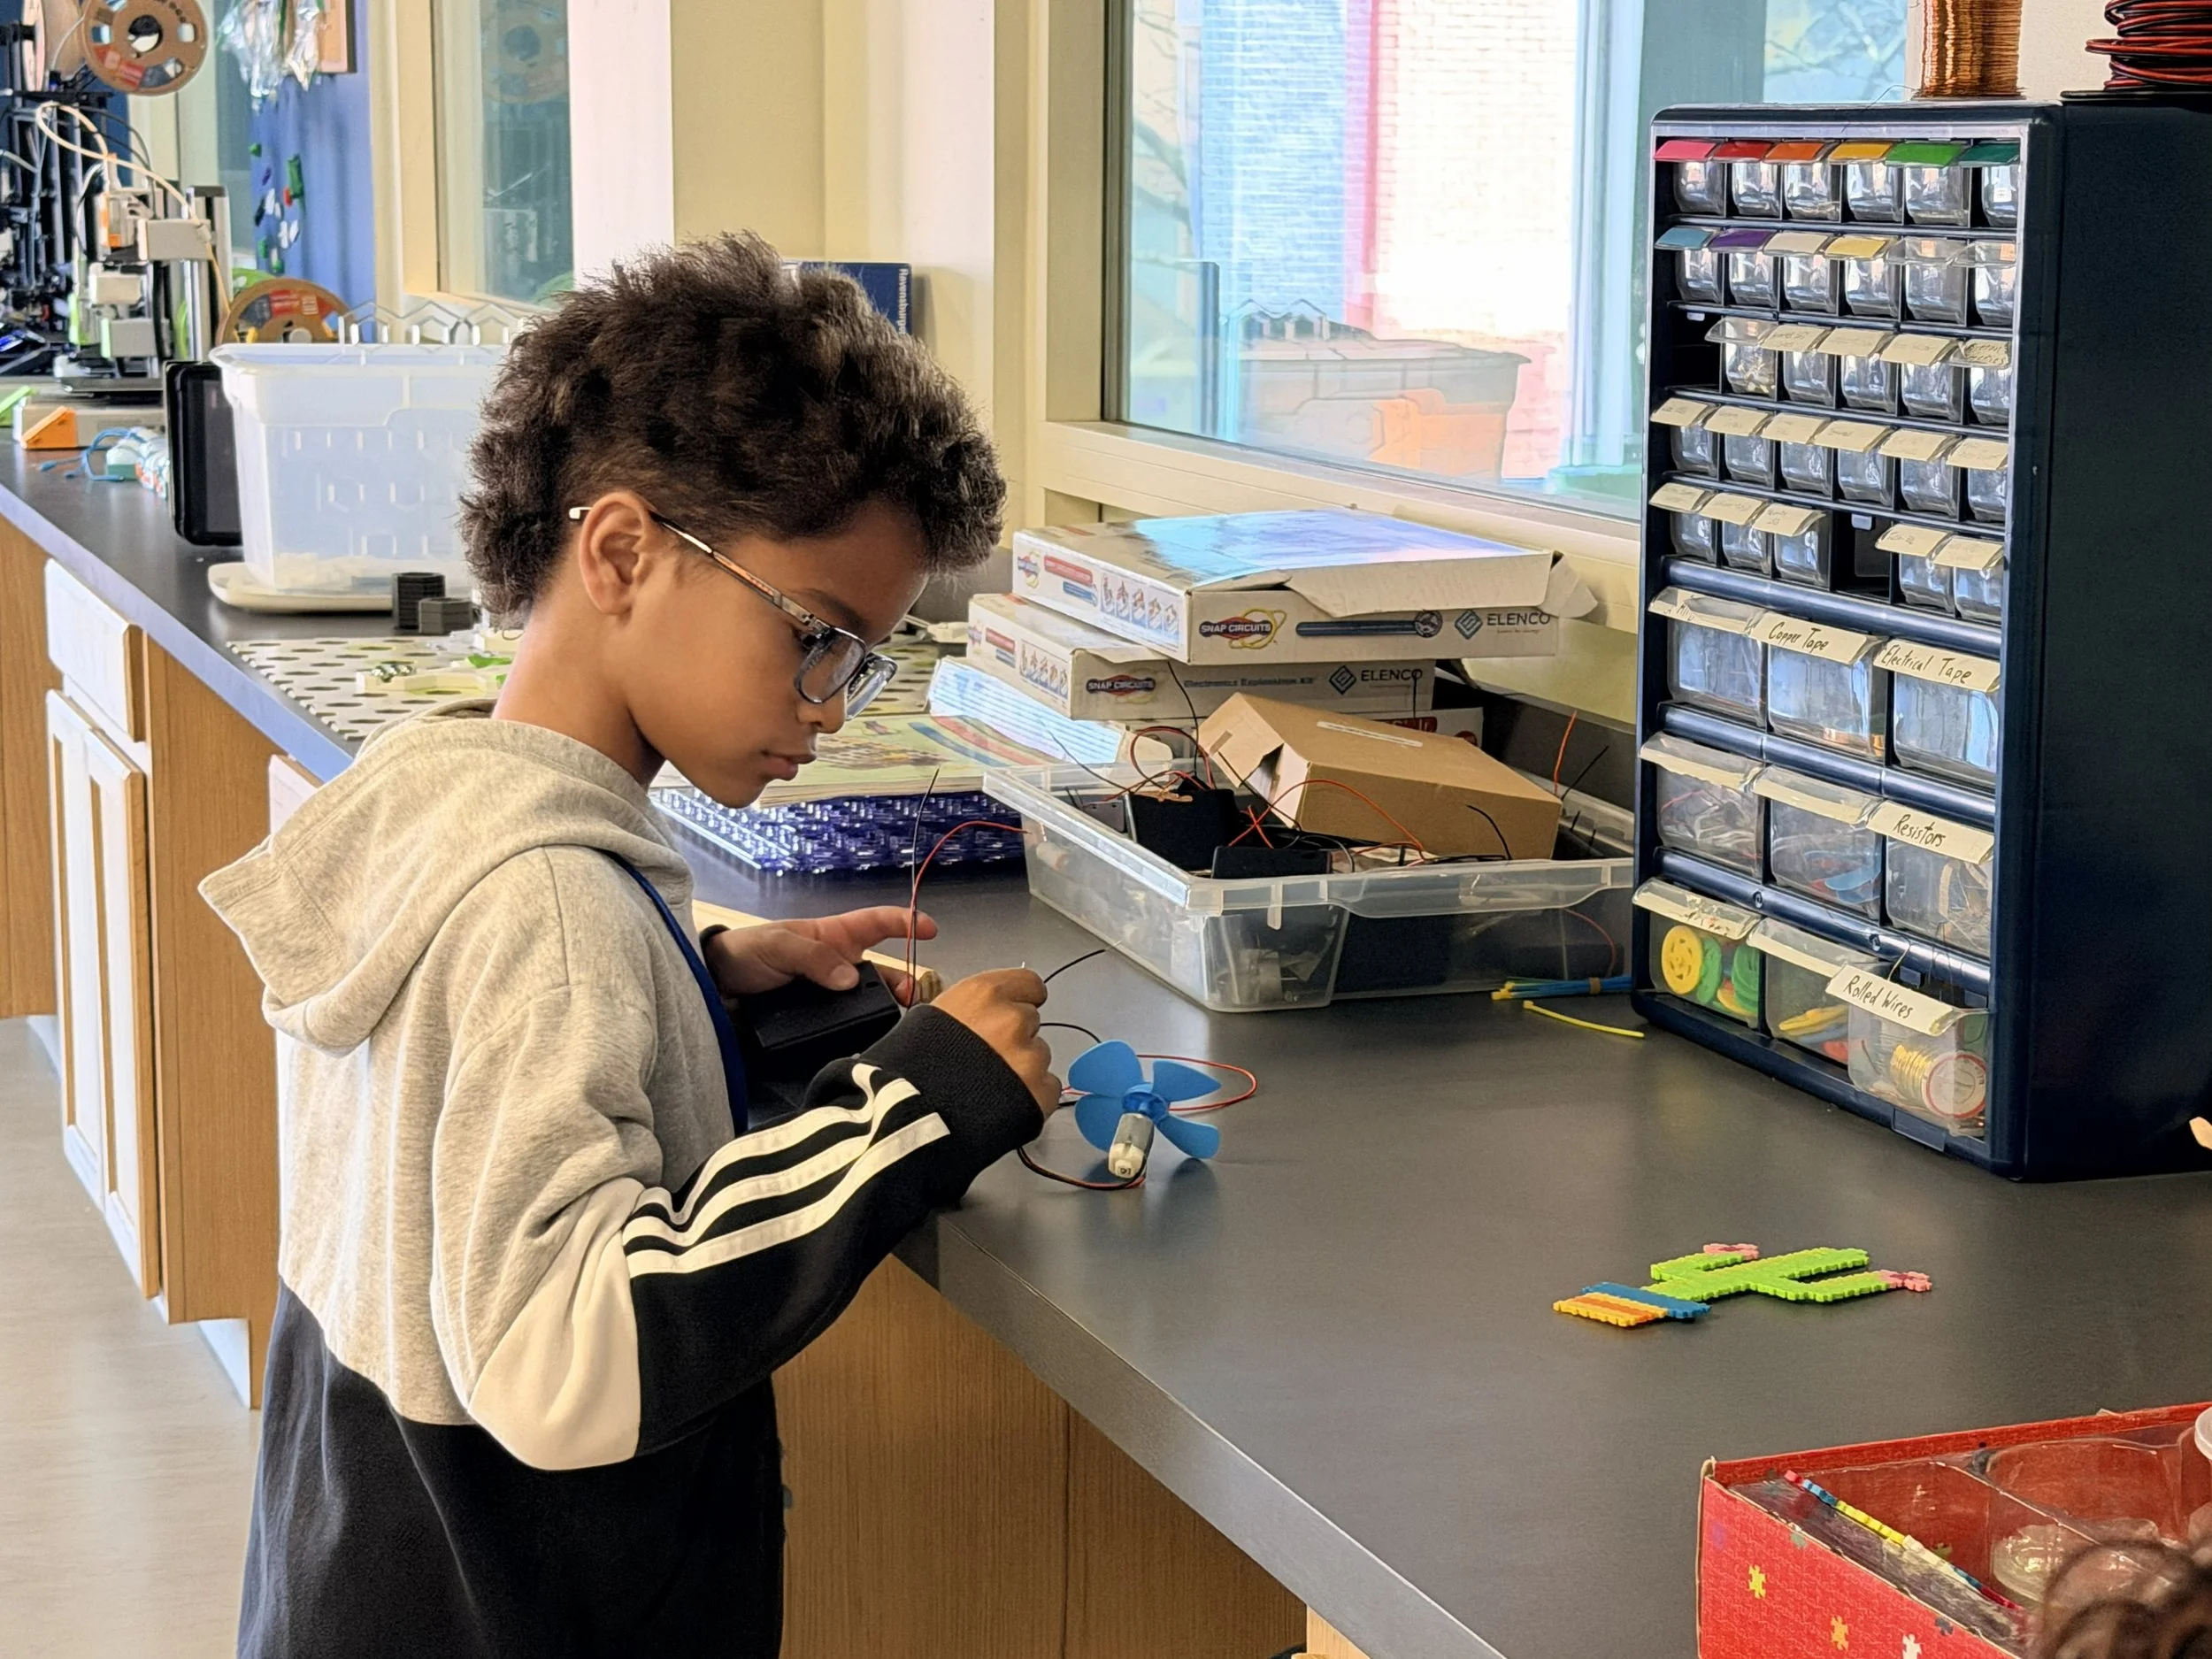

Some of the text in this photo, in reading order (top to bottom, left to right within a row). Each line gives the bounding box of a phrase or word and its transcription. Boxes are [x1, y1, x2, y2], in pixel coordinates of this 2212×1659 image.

[1201, 623, 1271, 633] SNAP CIRCUITS
[1486, 612, 1551, 626] ELENCO
[1768, 621, 1829, 653] Copper Tape
[1361, 669, 1423, 681] ELENCO
[1880, 644, 1972, 684] Electrical Tape
[1087, 681, 1112, 690] SNAP
[1893, 813, 1947, 847] Resistors
[1843, 975, 1913, 1018] Rolled Wires
